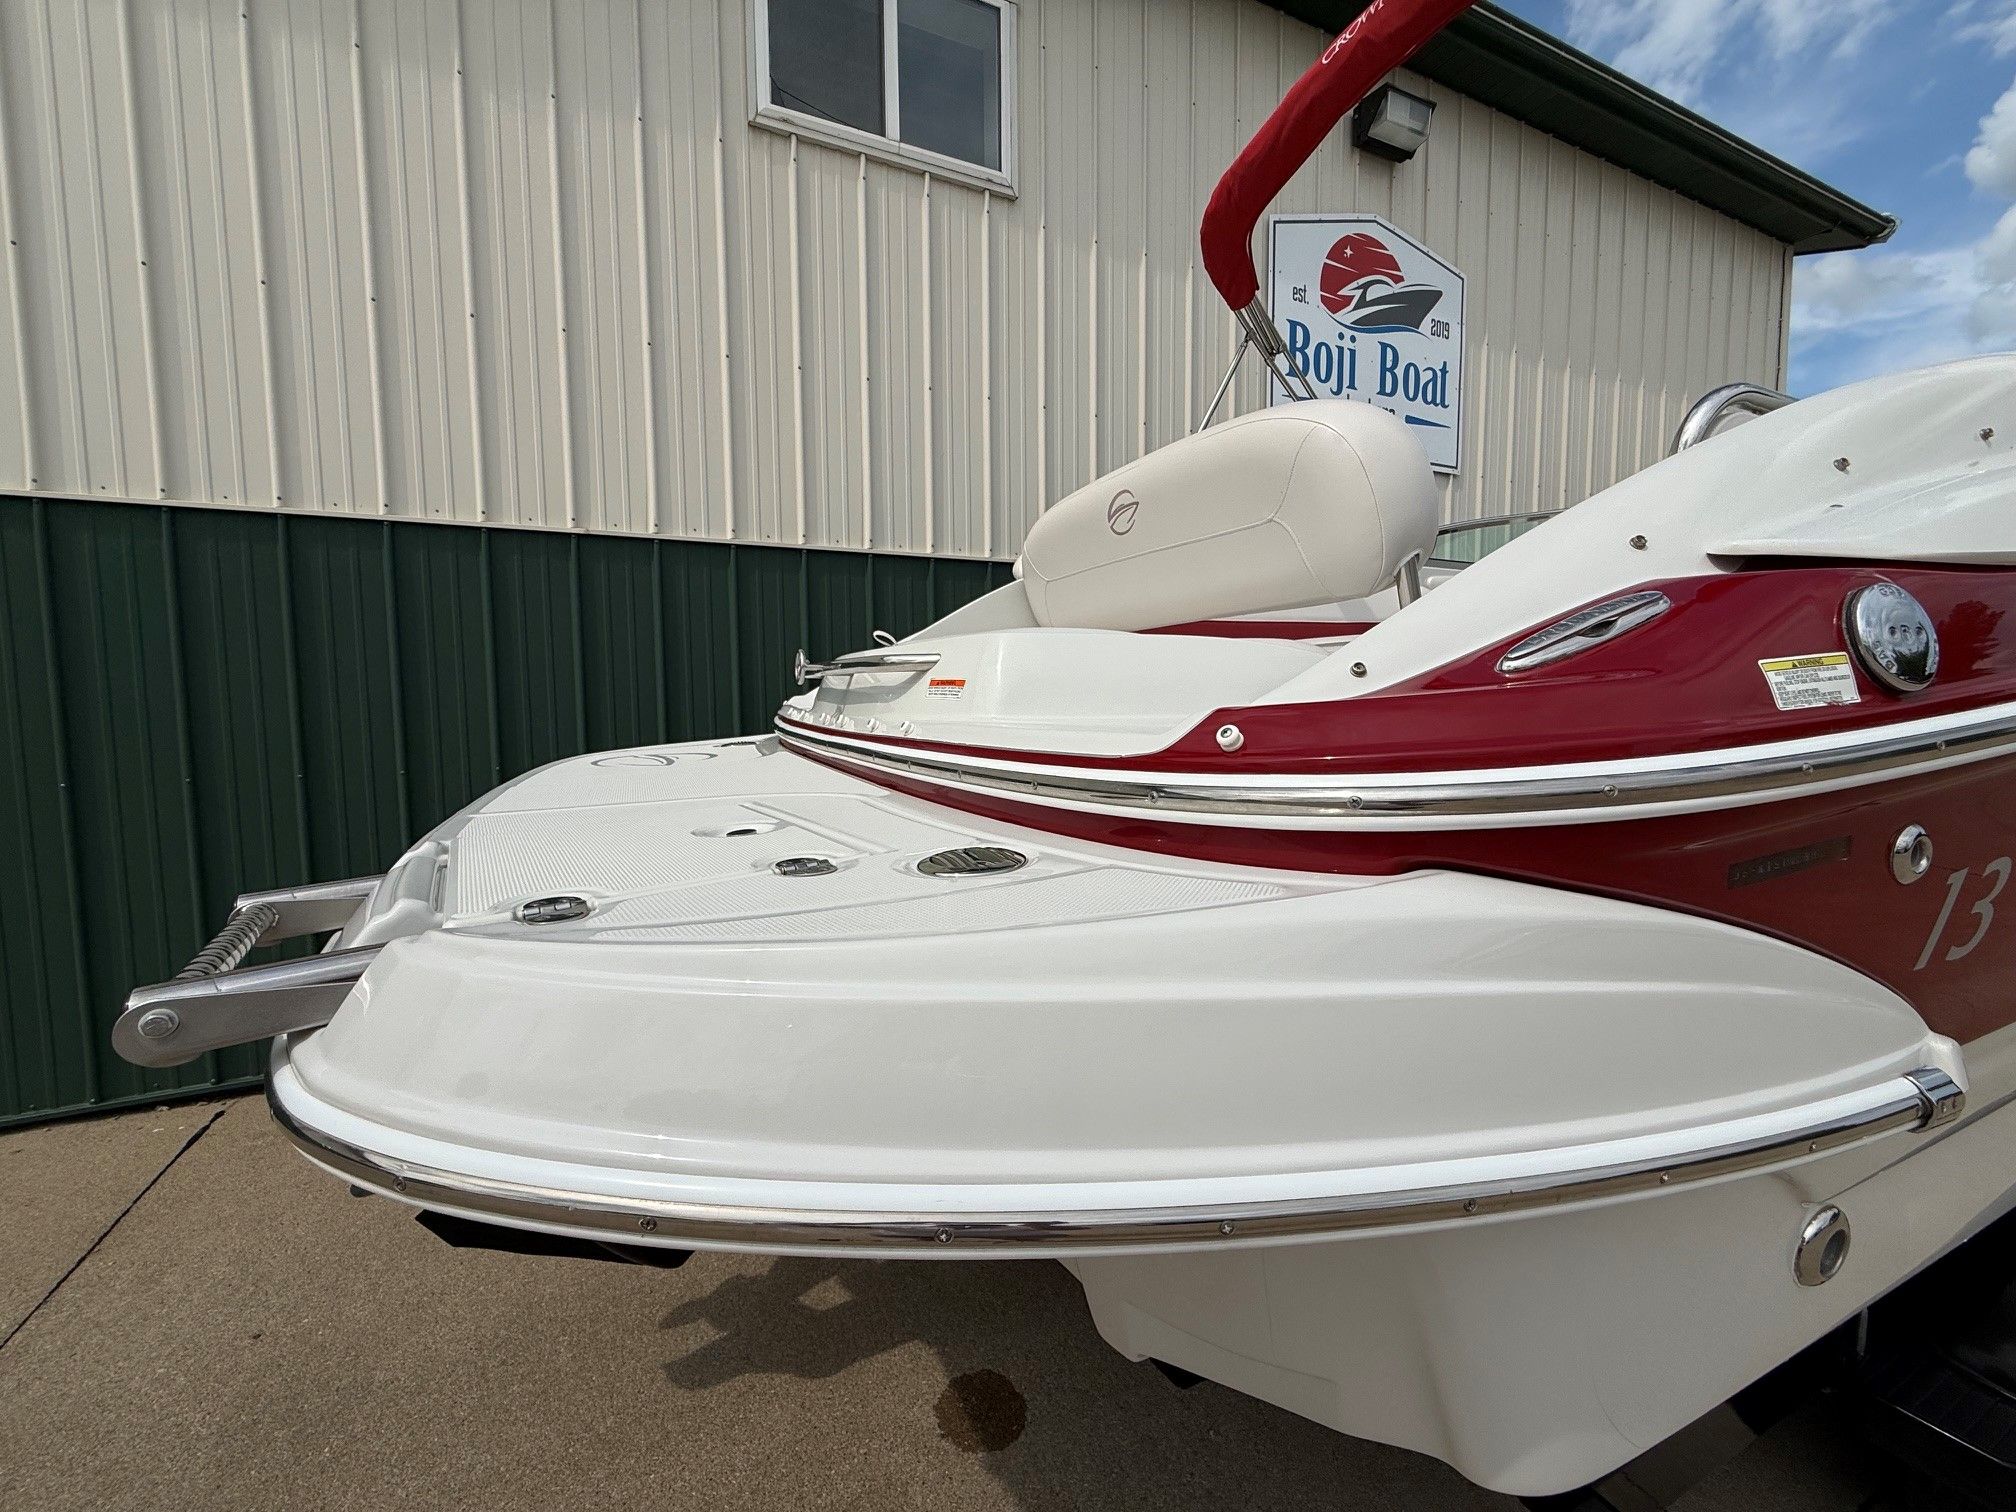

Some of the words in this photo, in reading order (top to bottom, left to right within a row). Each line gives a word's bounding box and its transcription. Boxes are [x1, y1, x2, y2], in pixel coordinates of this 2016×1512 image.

[1292, 284, 1310, 305] est.
[1430, 318, 1450, 340] 2019
[1285, 318, 1358, 396] Boji
[1376, 340, 1450, 409] Boat
[1913, 856, 2012, 971] 13
